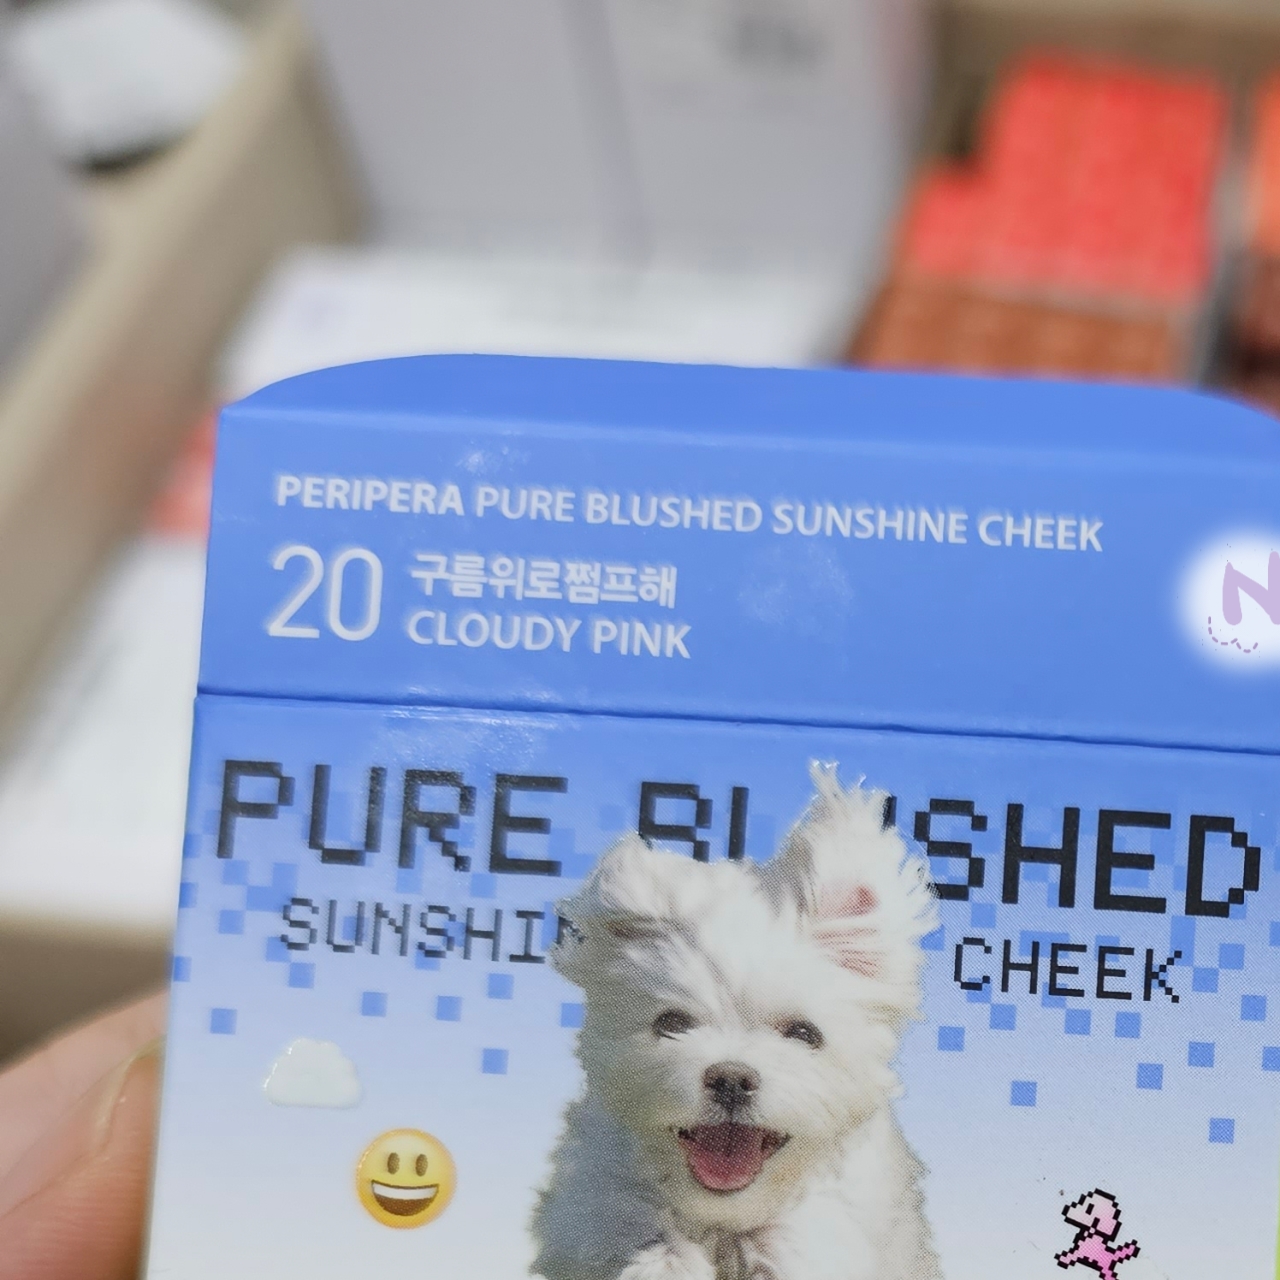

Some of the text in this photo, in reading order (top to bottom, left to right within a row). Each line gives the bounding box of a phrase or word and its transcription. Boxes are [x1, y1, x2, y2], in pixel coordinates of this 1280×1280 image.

[277, 475, 1104, 552] PERIPERA PURE BLUSHED SUNSHINE CHEEK
[268, 544, 384, 641] 20
[410, 553, 678, 609] 구름위로쩜프해
[405, 610, 692, 659] CLOUDY PINK
[217, 758, 1261, 918] PURE BSHED
[281, 897, 1182, 1003] SUNSHI CHEEK
